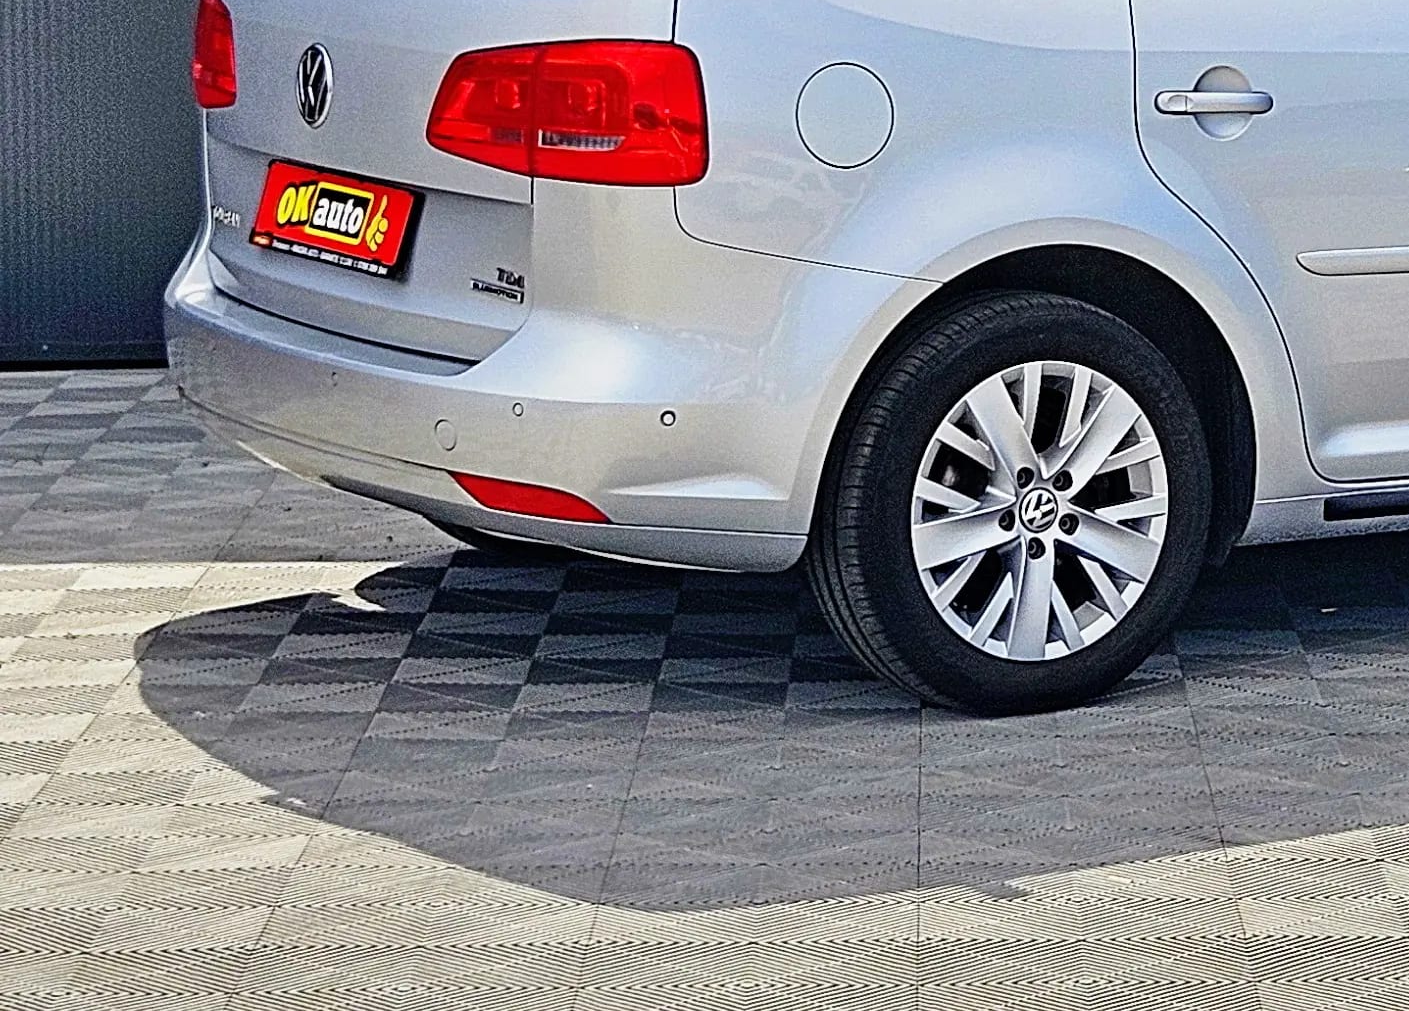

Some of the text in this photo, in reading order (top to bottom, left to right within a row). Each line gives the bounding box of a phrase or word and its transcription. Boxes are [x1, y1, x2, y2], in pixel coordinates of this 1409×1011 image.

[276, 185, 317, 224] OK
[312, 197, 364, 235] auto
[496, 267, 525, 289] TDI
